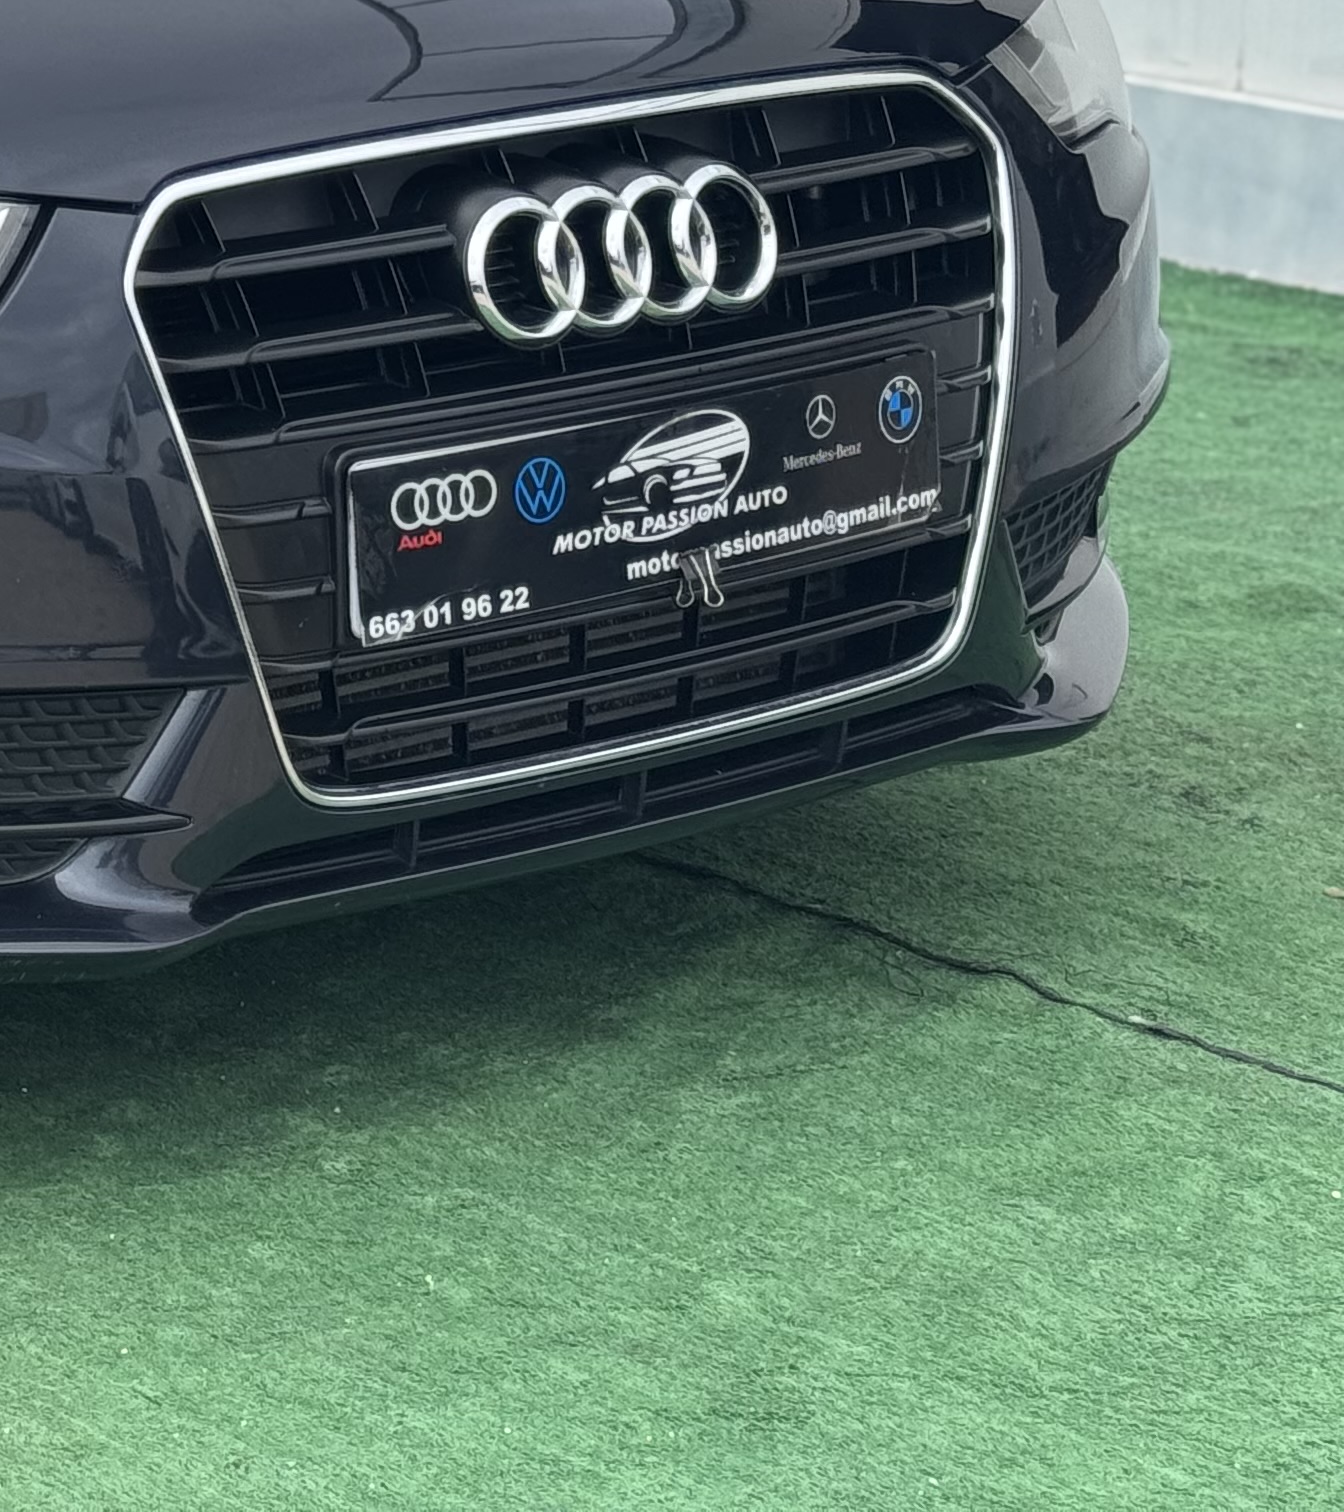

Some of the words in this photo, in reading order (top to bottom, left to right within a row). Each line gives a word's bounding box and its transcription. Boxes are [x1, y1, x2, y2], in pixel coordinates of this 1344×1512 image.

[782, 442, 862, 473] Mercedes-Benz
[397, 529, 443, 552] Audi
[552, 520, 635, 555] MOTOR
[641, 499, 728, 536] PASSION
[733, 486, 788, 515] AUTO
[369, 609, 415, 638] 663
[424, 601, 451, 629] 01
[462, 594, 492, 620] 96
[499, 586, 530, 614] 22
